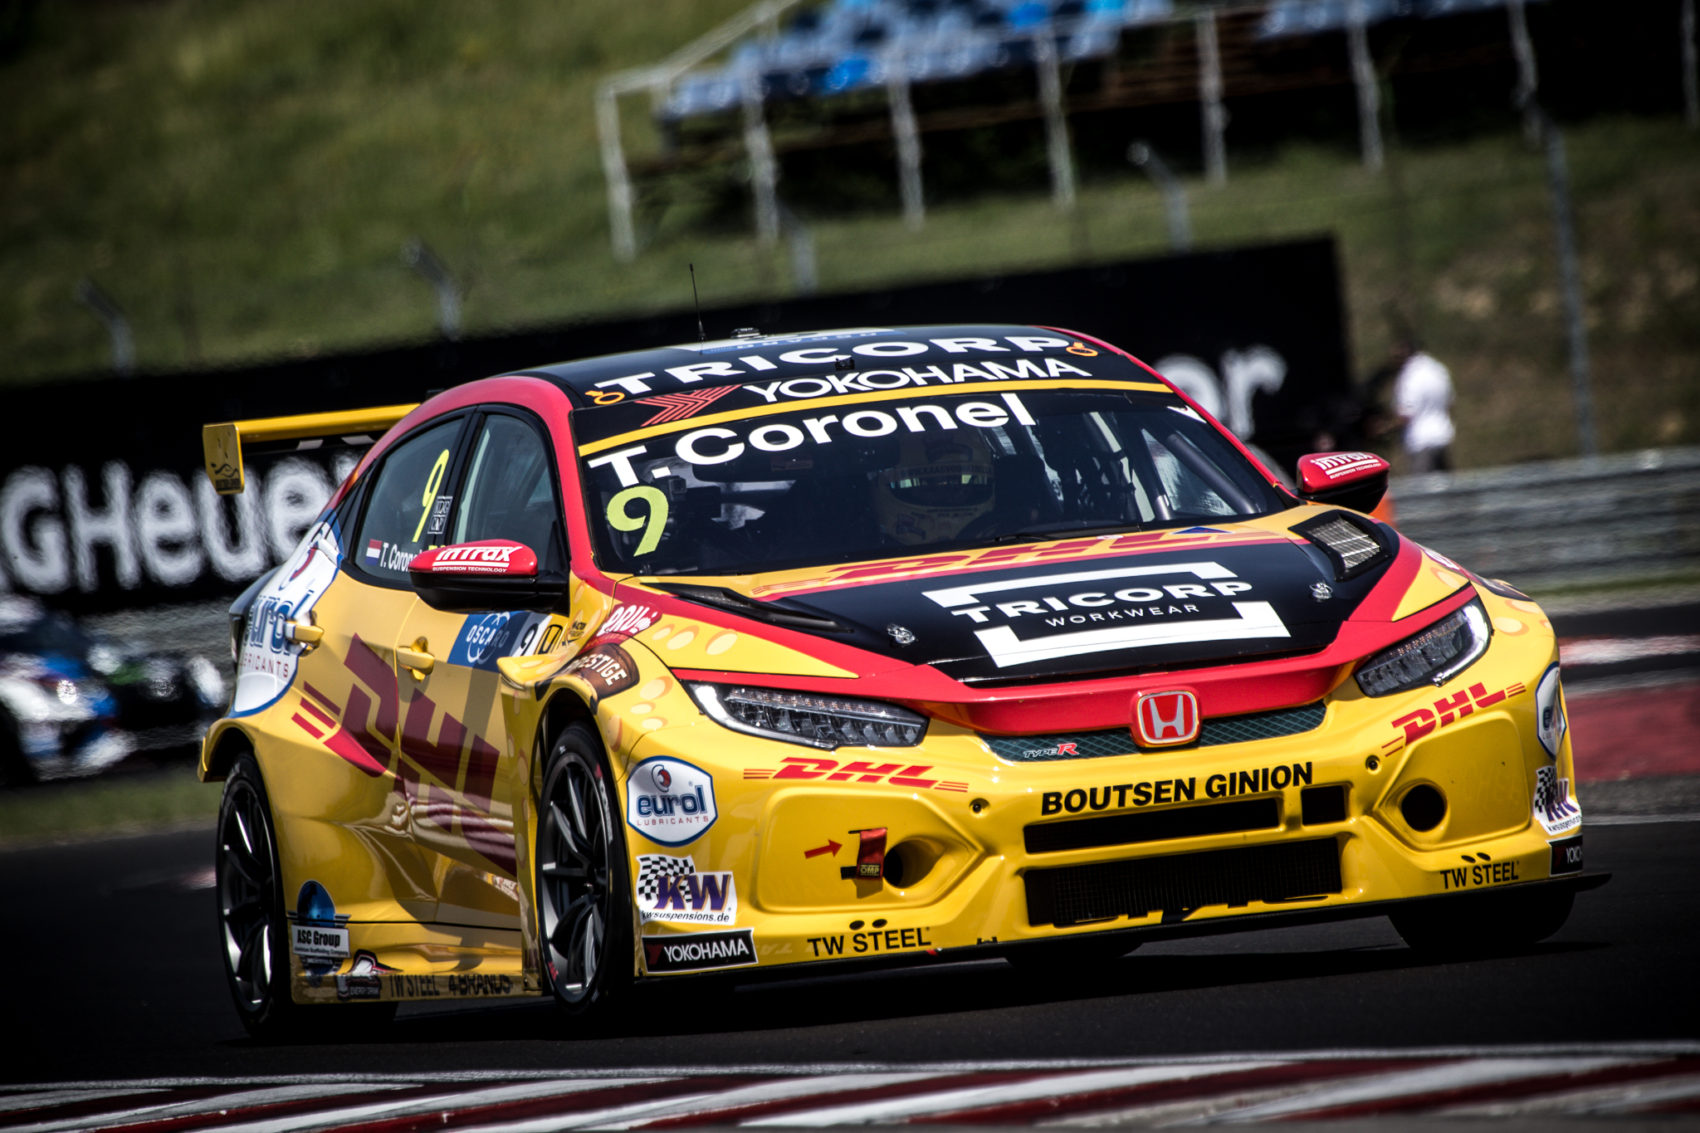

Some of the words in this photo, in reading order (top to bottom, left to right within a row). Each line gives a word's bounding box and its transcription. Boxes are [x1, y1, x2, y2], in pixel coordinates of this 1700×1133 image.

[595, 336, 1070, 395] TRICORP
[743, 357, 1093, 403] YOKOHAMA
[412, 449, 449, 542] 9
[606, 486, 669, 557] 9
[951, 581, 1253, 623] TRICORP
[1044, 604, 1201, 627] WORKWEAR
[1391, 682, 1506, 746] DHL
[772, 757, 939, 789] DHL
[1041, 777, 1196, 816] BOUTSEN
[1205, 762, 1313, 798] GINION
[636, 785, 708, 818] eurol
[637, 815, 709, 827] LUBRICANTS
[859, 865, 881, 876] OMP
[1440, 867, 1467, 890] TW
[1472, 861, 1519, 886] STEEL
[653, 874, 731, 912] KW
[314, 930, 341, 948] Group
[664, 938, 750, 963] YOKOHAMA
[807, 935, 844, 957] TW
[853, 927, 931, 953] STEEL
